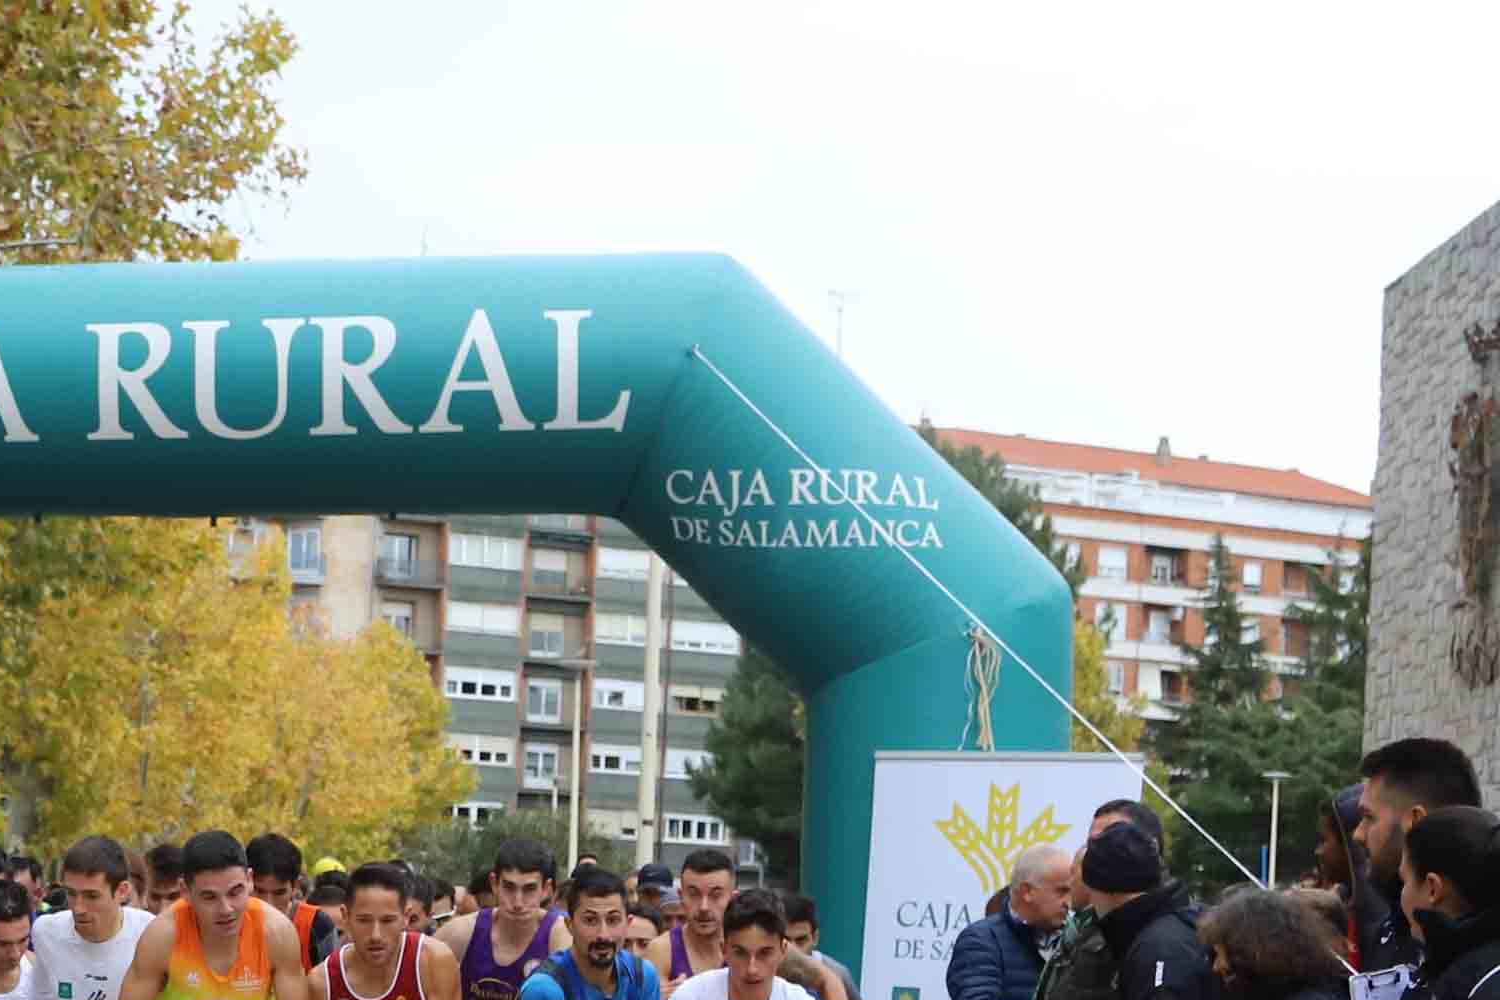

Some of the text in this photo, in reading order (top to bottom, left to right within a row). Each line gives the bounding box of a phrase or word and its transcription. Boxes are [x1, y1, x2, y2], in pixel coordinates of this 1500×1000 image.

[85, 307, 632, 441] RURAL
[665, 468, 940, 516] CAJA RURAL
[670, 516, 944, 549] DE SALAMANCA
[896, 901, 972, 937] CAJA
[894, 939, 924, 960] DE
